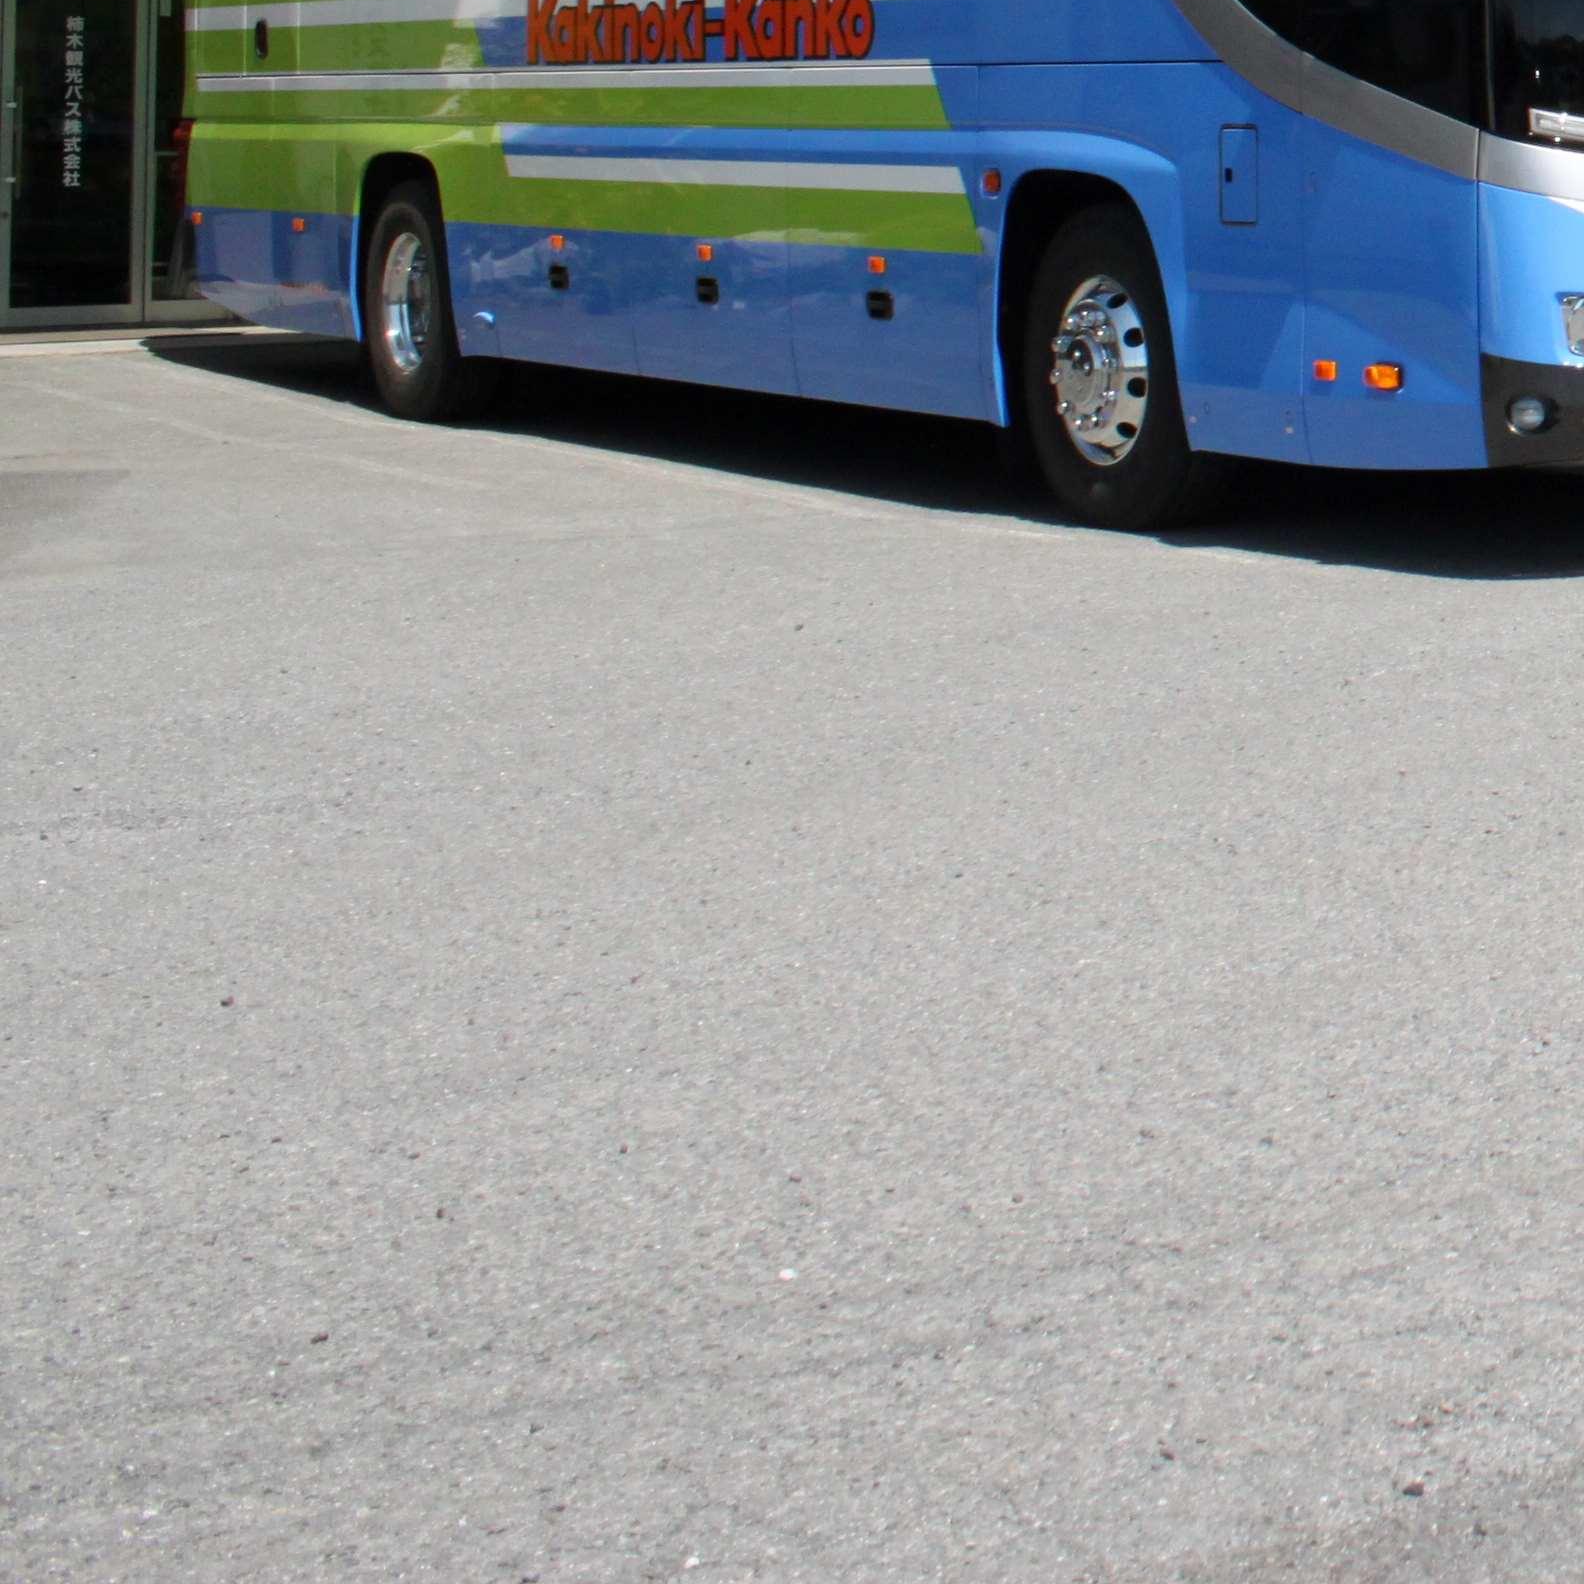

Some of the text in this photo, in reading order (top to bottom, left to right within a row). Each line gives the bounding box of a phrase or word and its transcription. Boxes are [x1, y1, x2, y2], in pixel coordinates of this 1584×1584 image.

[61, 16, 85, 187] 柿木観光バス株式会社
